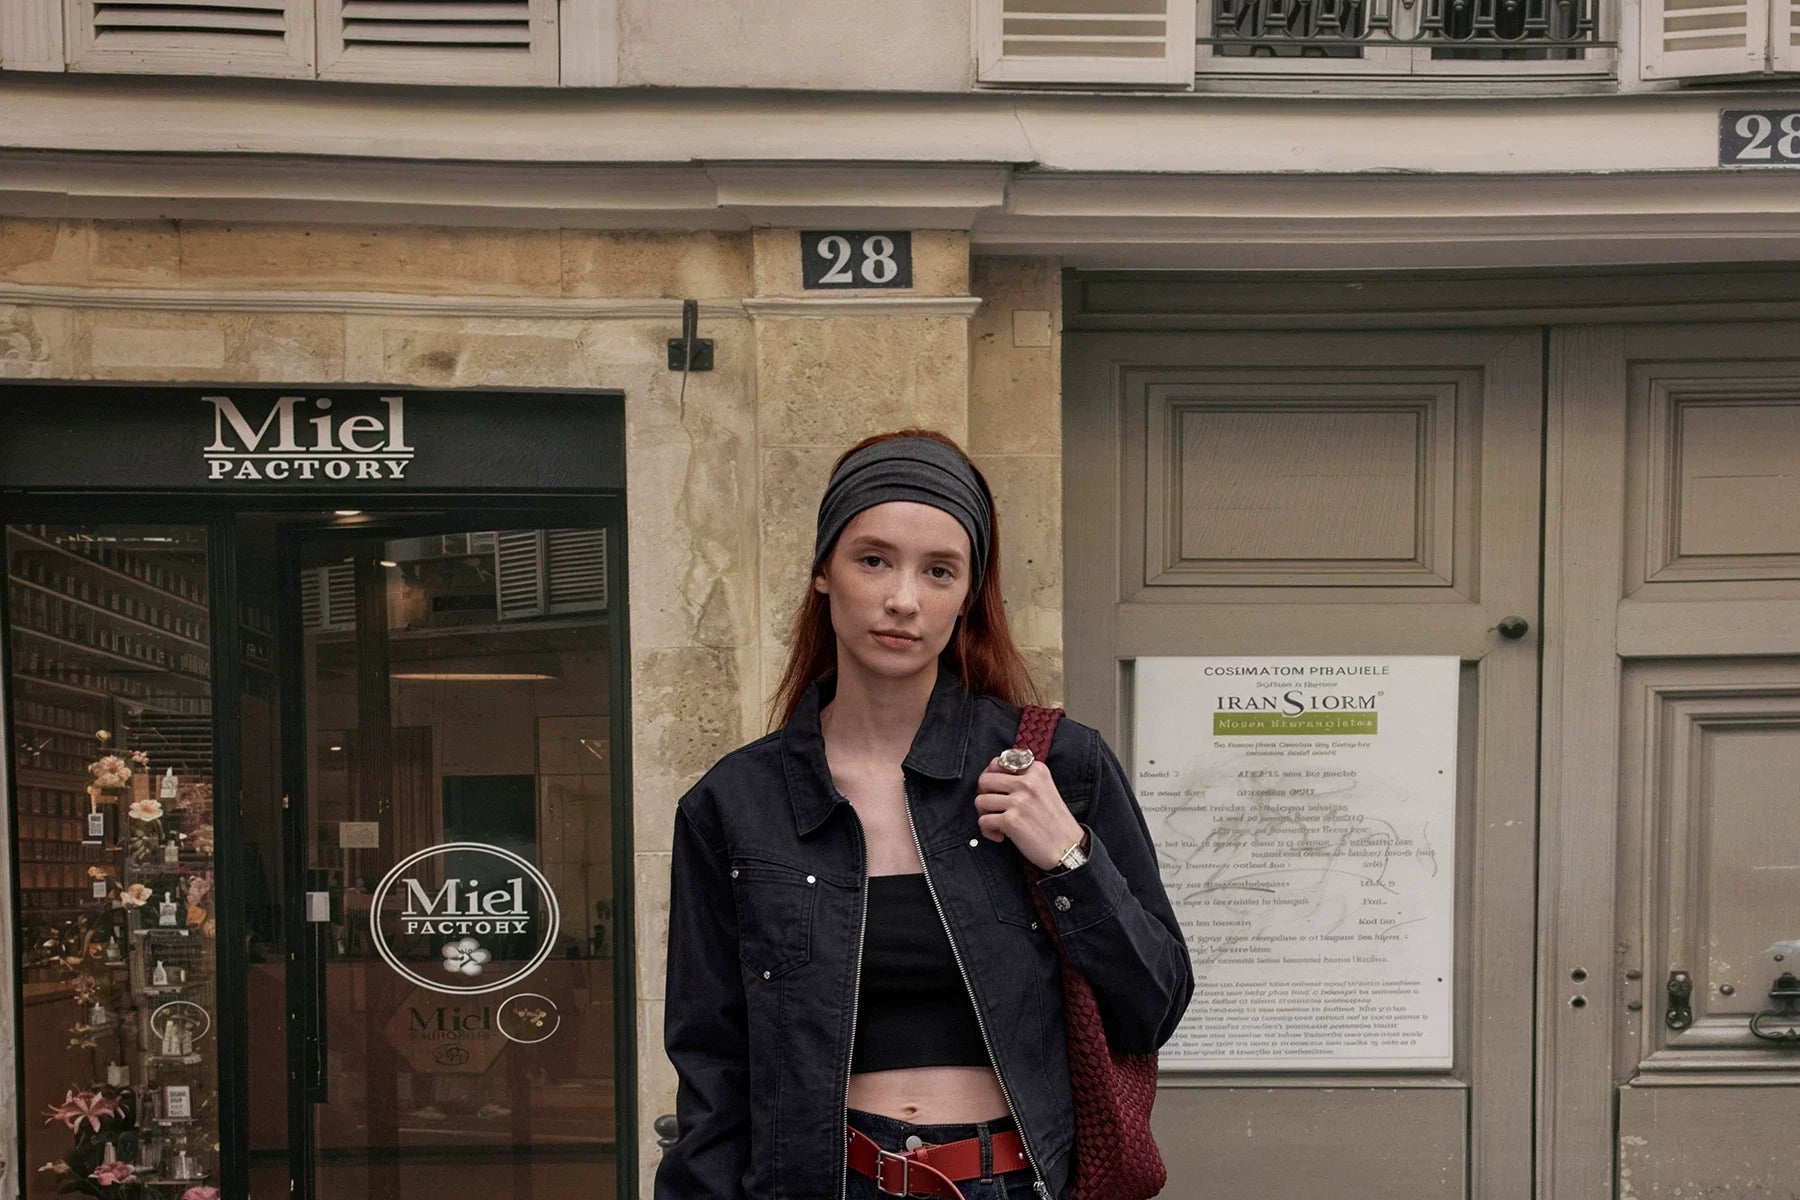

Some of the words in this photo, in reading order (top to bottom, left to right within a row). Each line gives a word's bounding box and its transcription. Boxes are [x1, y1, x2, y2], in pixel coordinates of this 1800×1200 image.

[1754, 113, 1800, 162] 28
[817, 235, 898, 284] 28
[201, 396, 415, 453] Miel
[401, 877, 529, 916] Miel
